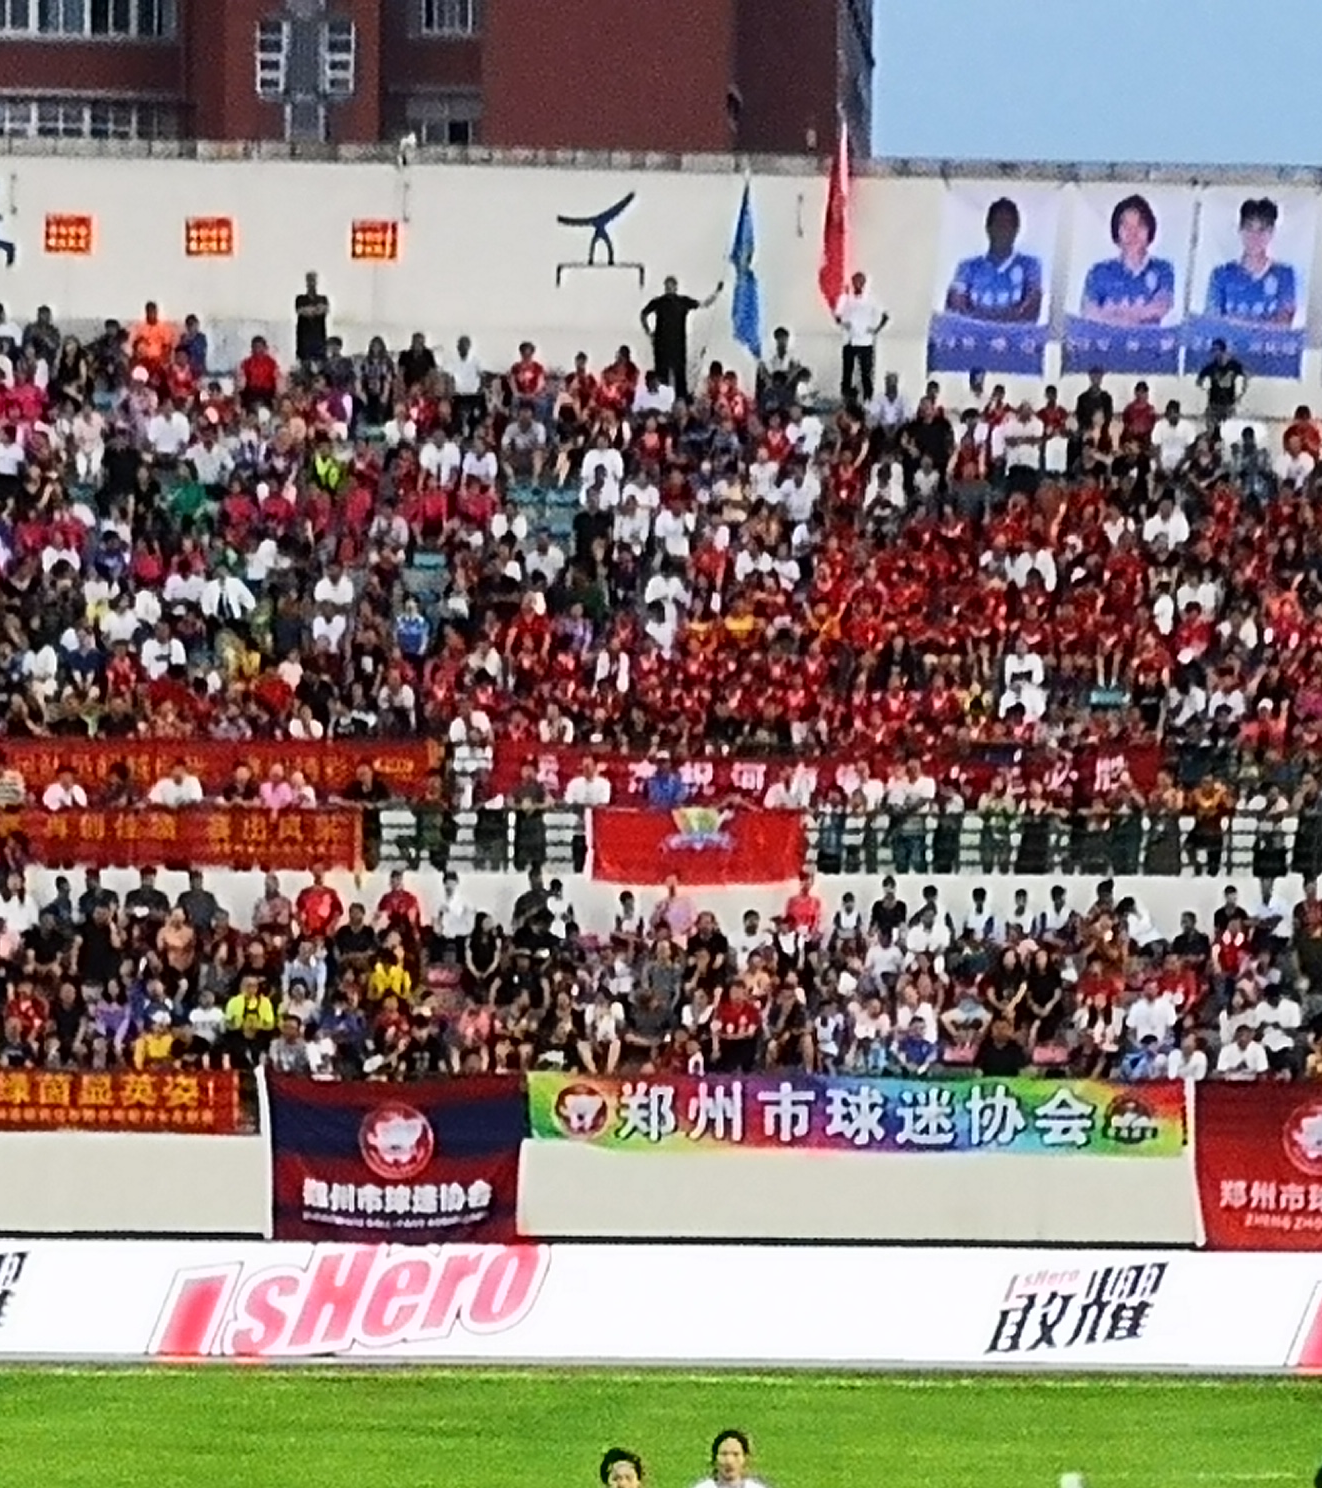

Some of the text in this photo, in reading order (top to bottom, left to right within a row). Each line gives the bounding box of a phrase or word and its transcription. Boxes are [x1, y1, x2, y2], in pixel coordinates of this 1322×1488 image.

[617, 1080, 1097, 1146] 郑州市球迷协会
